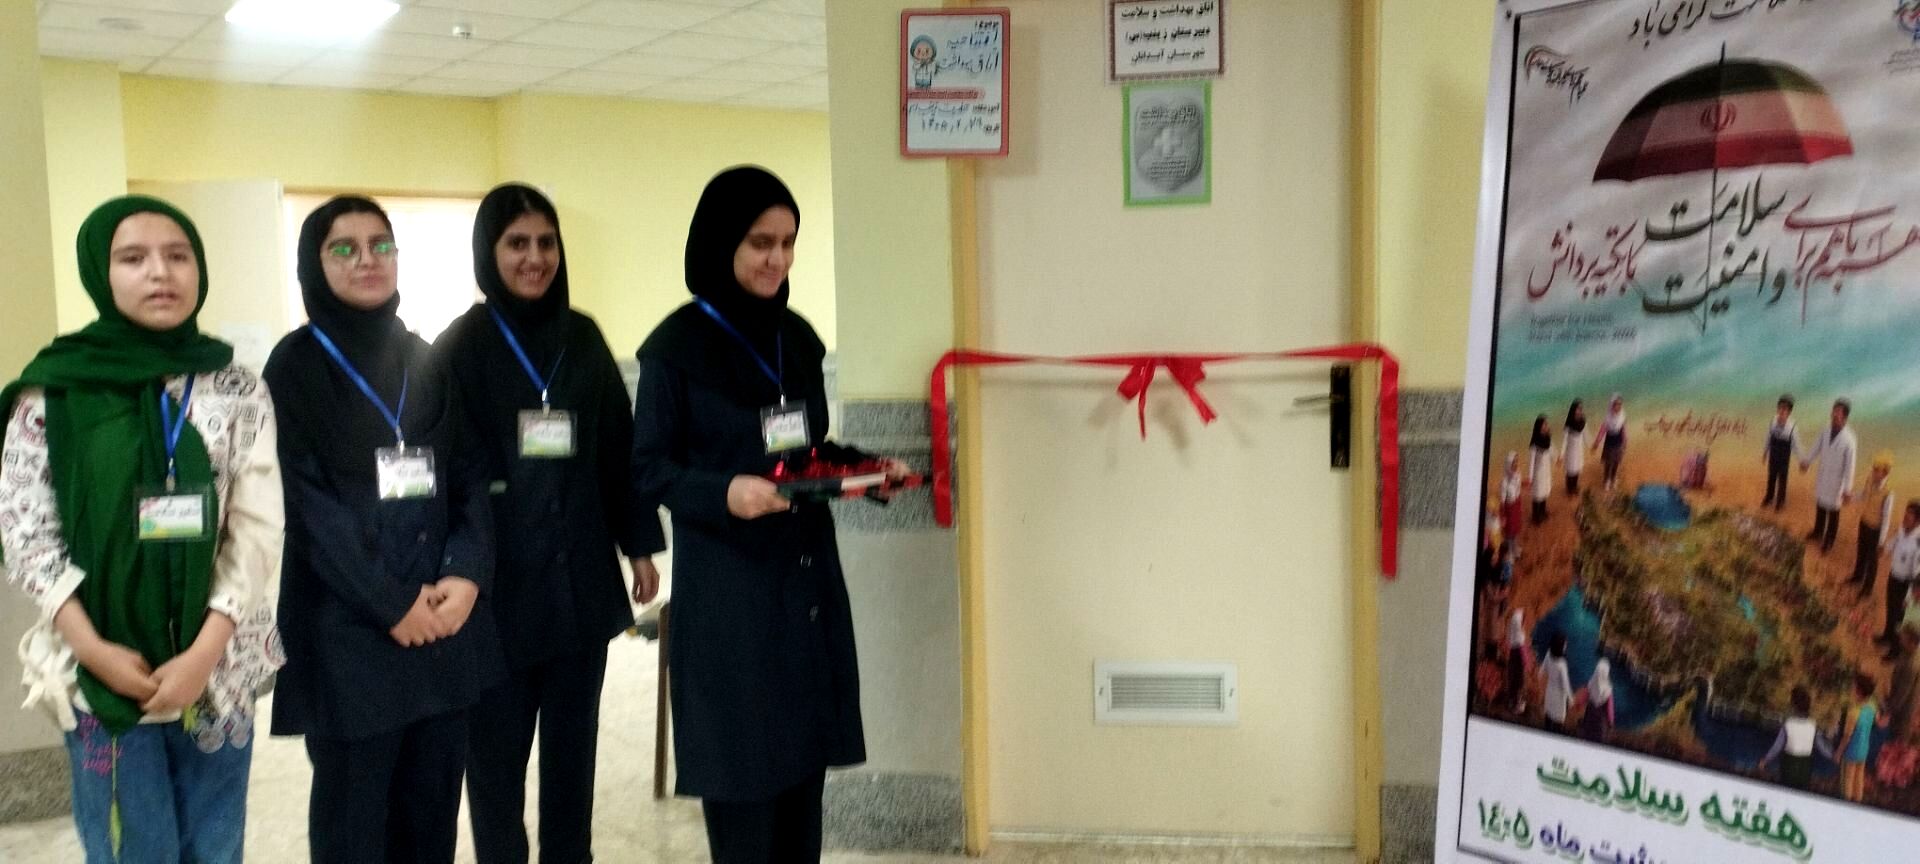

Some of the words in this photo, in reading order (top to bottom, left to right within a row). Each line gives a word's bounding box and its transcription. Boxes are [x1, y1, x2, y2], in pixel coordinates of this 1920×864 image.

[1160, 3, 1193, 16] بهداشت
[1536, 757, 1689, 824] سلامت
[1699, 791, 1812, 858] هفته
